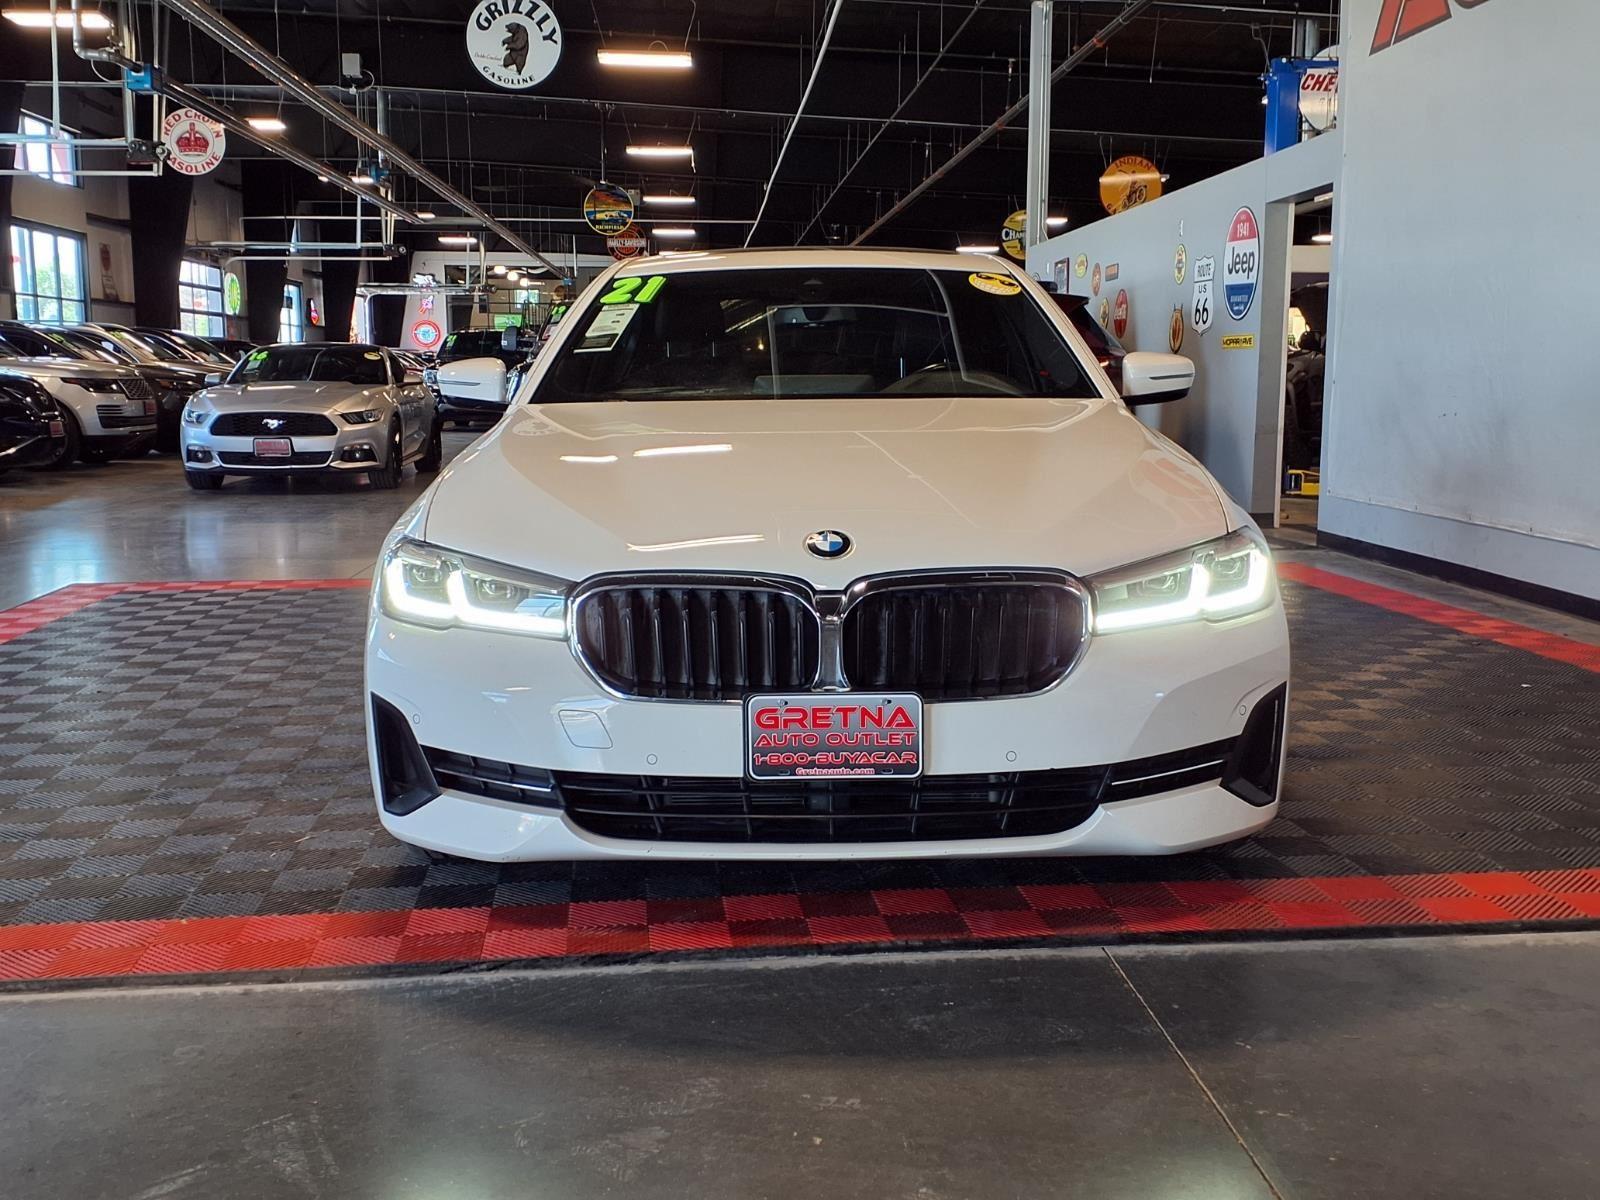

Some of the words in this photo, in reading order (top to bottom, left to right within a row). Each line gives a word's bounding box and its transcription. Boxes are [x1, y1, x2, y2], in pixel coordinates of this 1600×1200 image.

[475, 0, 558, 45] GRIZZLY
[482, 65, 536, 85] GASOLINE
[1301, 73, 1338, 93] CHE
[168, 151, 222, 174] ASOLINE
[1114, 157, 1153, 171] INDIAN
[1237, 222, 1250, 238] 1941
[1197, 263, 1212, 278] ROUTE
[1227, 246, 1255, 280] Jeep
[600, 275, 667, 305] 21
[1198, 284, 1207, 294] US
[1194, 297, 1209, 326] 66
[754, 705, 916, 730] GRETNA
[754, 733, 819, 747] AUTO
[825, 731, 917, 746] OUTLET
[753, 751, 917, 765] 1-800-BUYACAR
